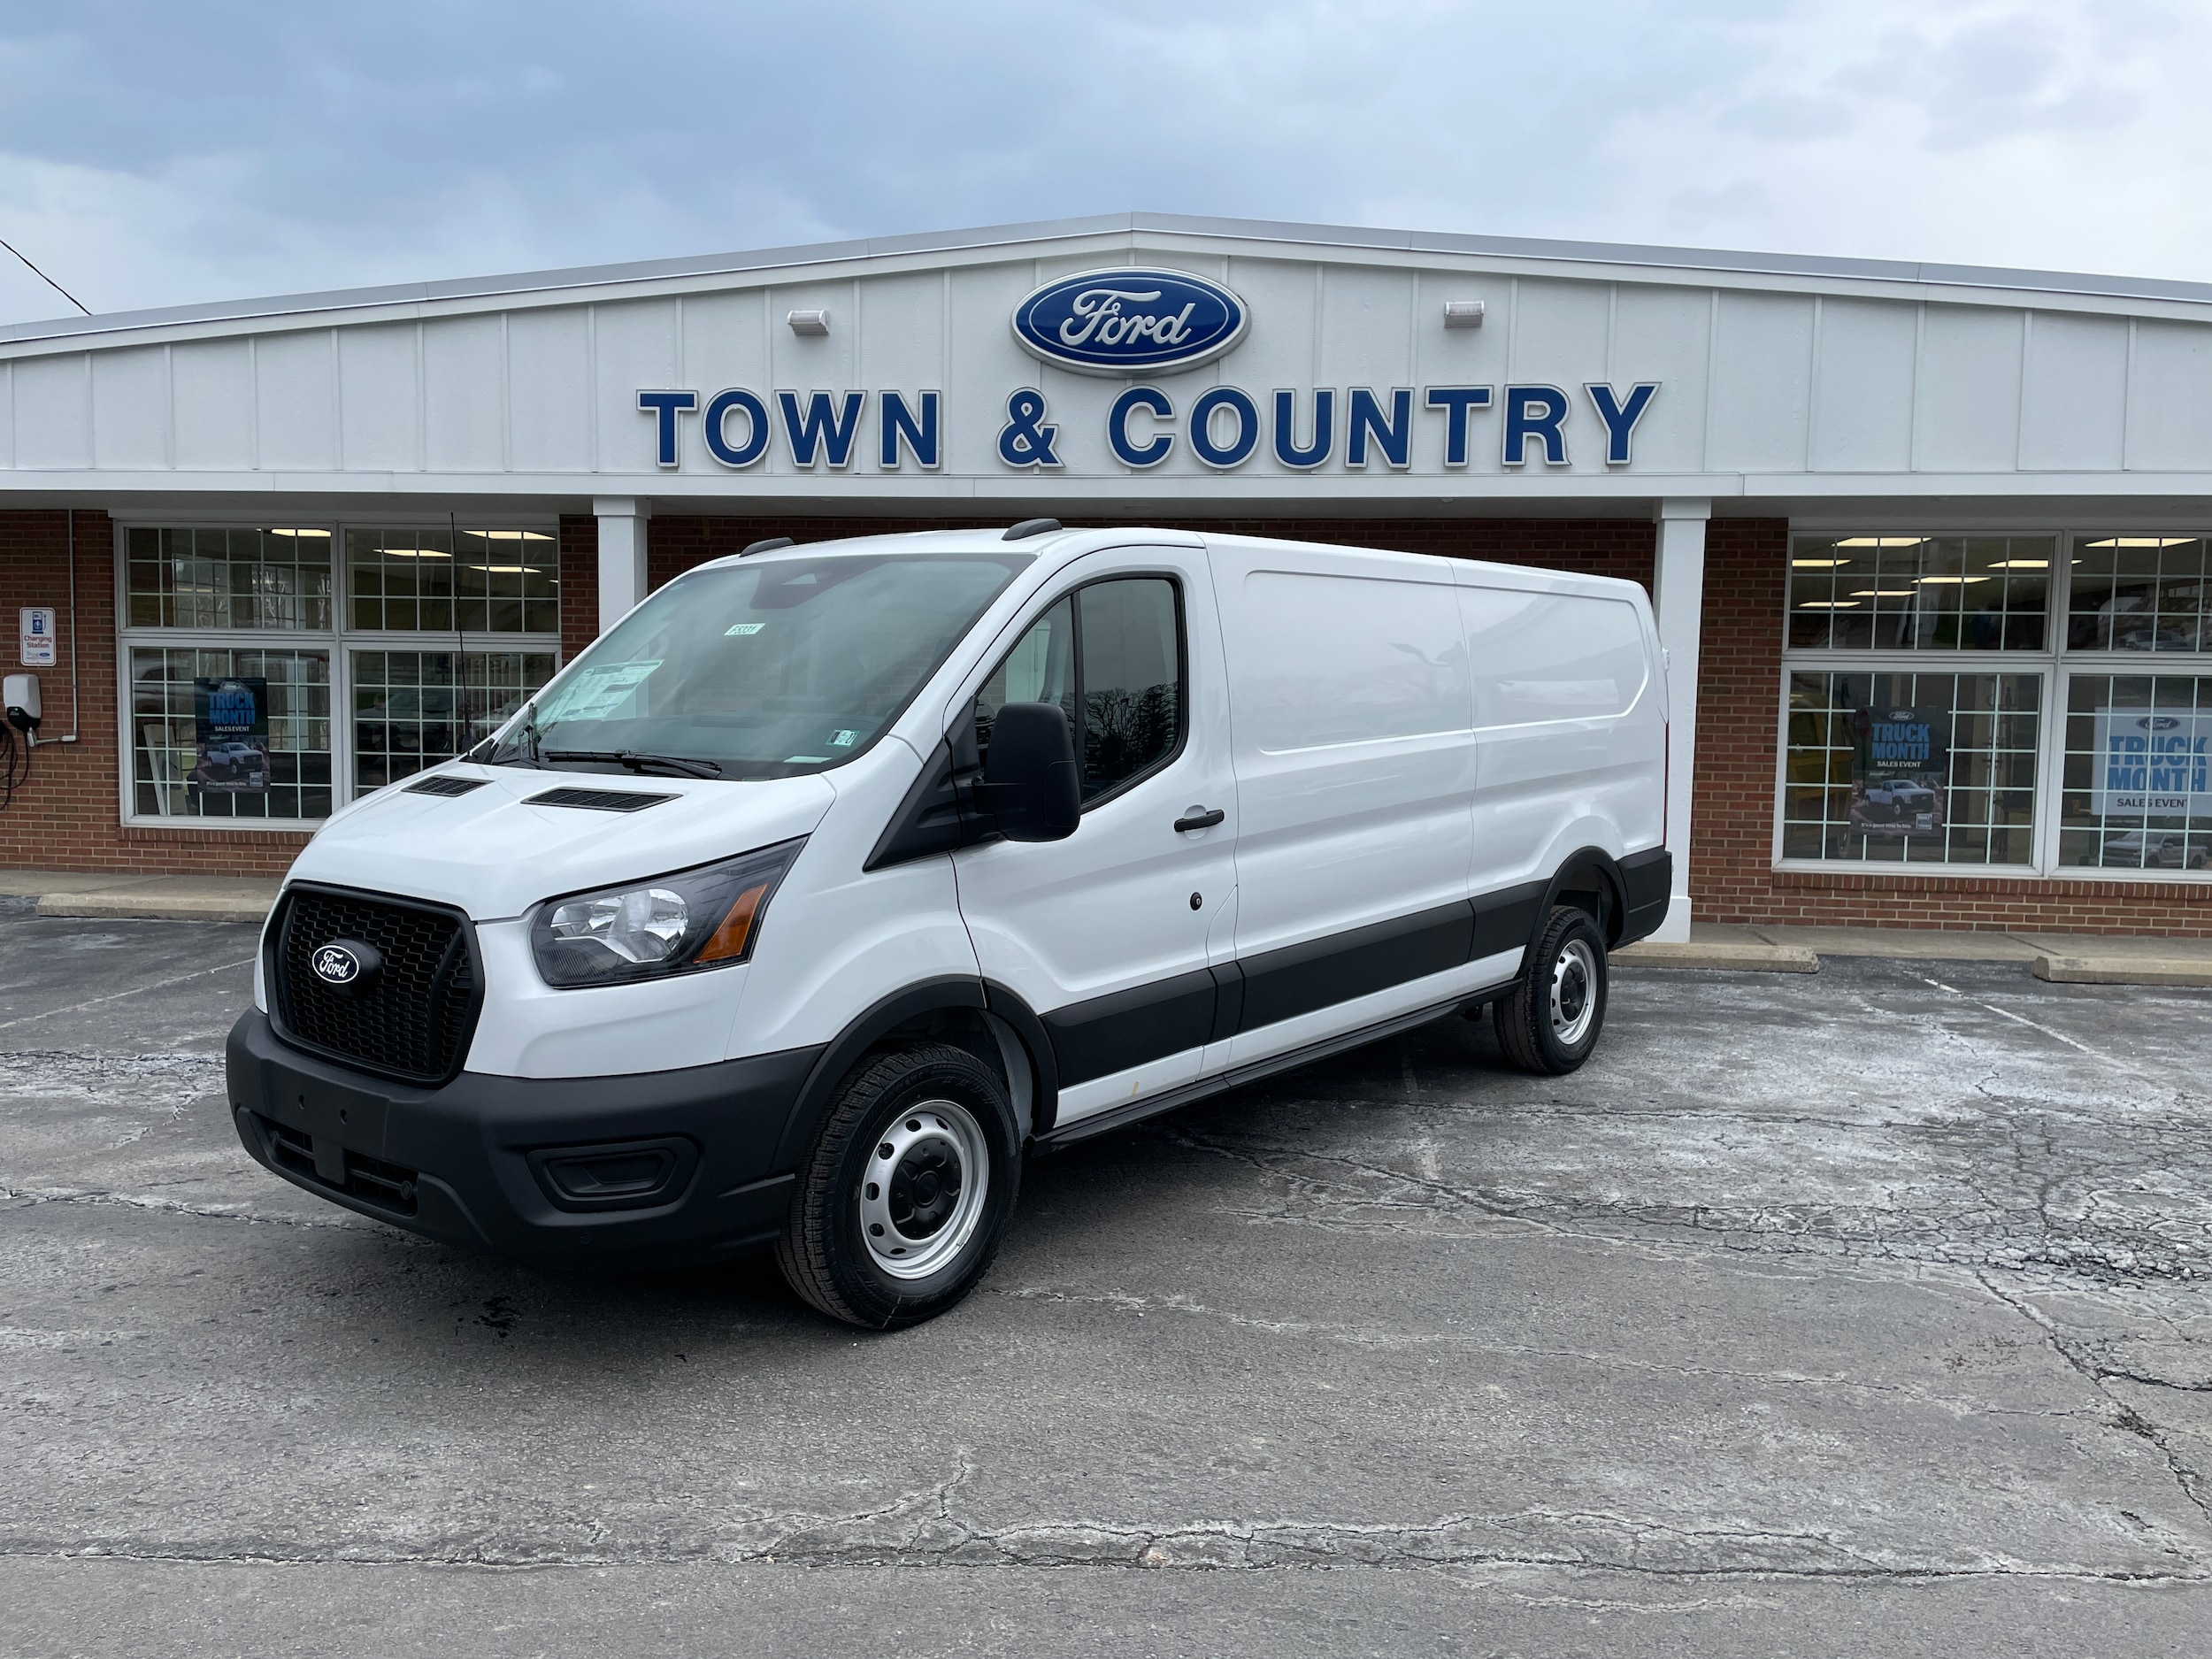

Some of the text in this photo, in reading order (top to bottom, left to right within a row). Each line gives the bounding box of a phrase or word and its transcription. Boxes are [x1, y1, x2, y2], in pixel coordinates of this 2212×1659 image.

[1059, 288, 1196, 346] Ford
[635, 381, 1663, 469] TOWN & COUNTRY
[208, 693, 254, 709] TRUCK
[210, 710, 255, 725] MONTH
[1871, 724, 1930, 741] TRUCK
[1871, 743, 1930, 760] MONTH
[2109, 735, 2208, 766] TRUCK
[2108, 767, 2207, 793] MONTH
[2116, 798, 2153, 808] SALES
[319, 950, 349, 977] Ford
